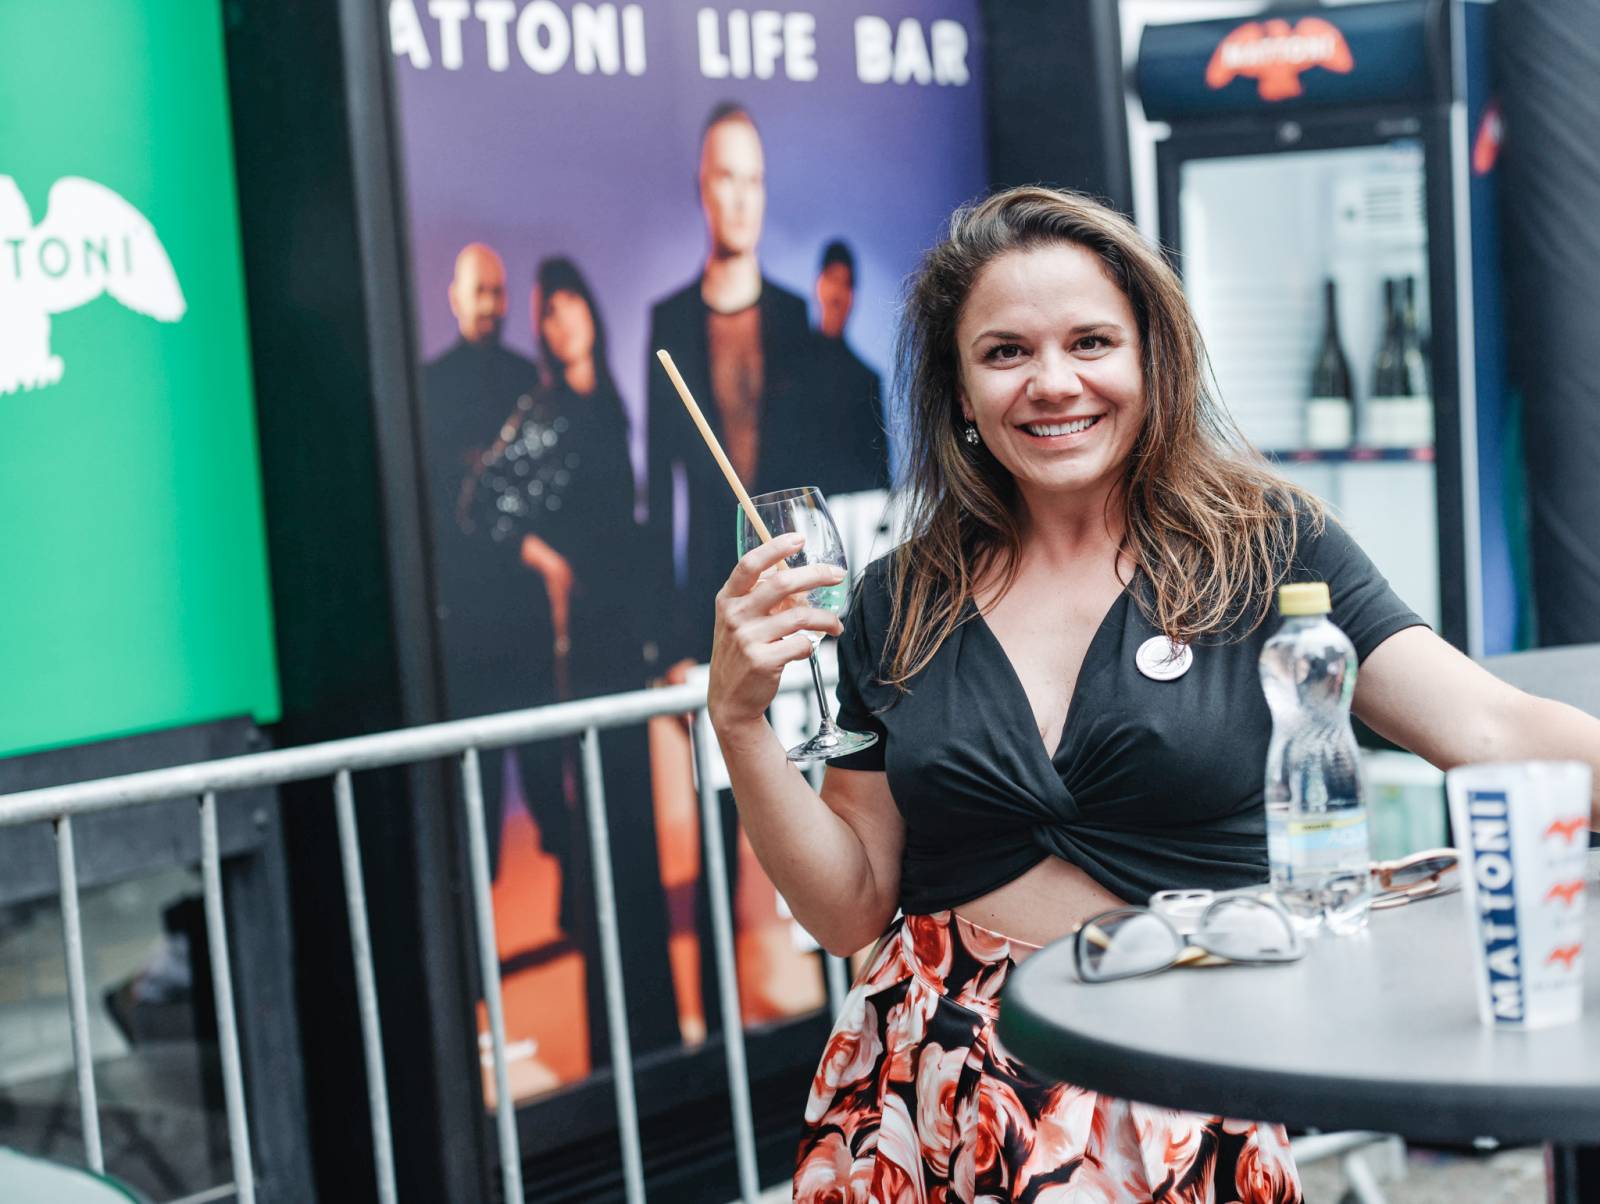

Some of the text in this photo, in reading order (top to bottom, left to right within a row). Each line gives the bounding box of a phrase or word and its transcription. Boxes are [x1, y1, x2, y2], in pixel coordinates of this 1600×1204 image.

[699, 8, 819, 82] LIFE
[854, 15, 971, 87] BAR
[1469, 800, 1523, 1020] MATTONI
